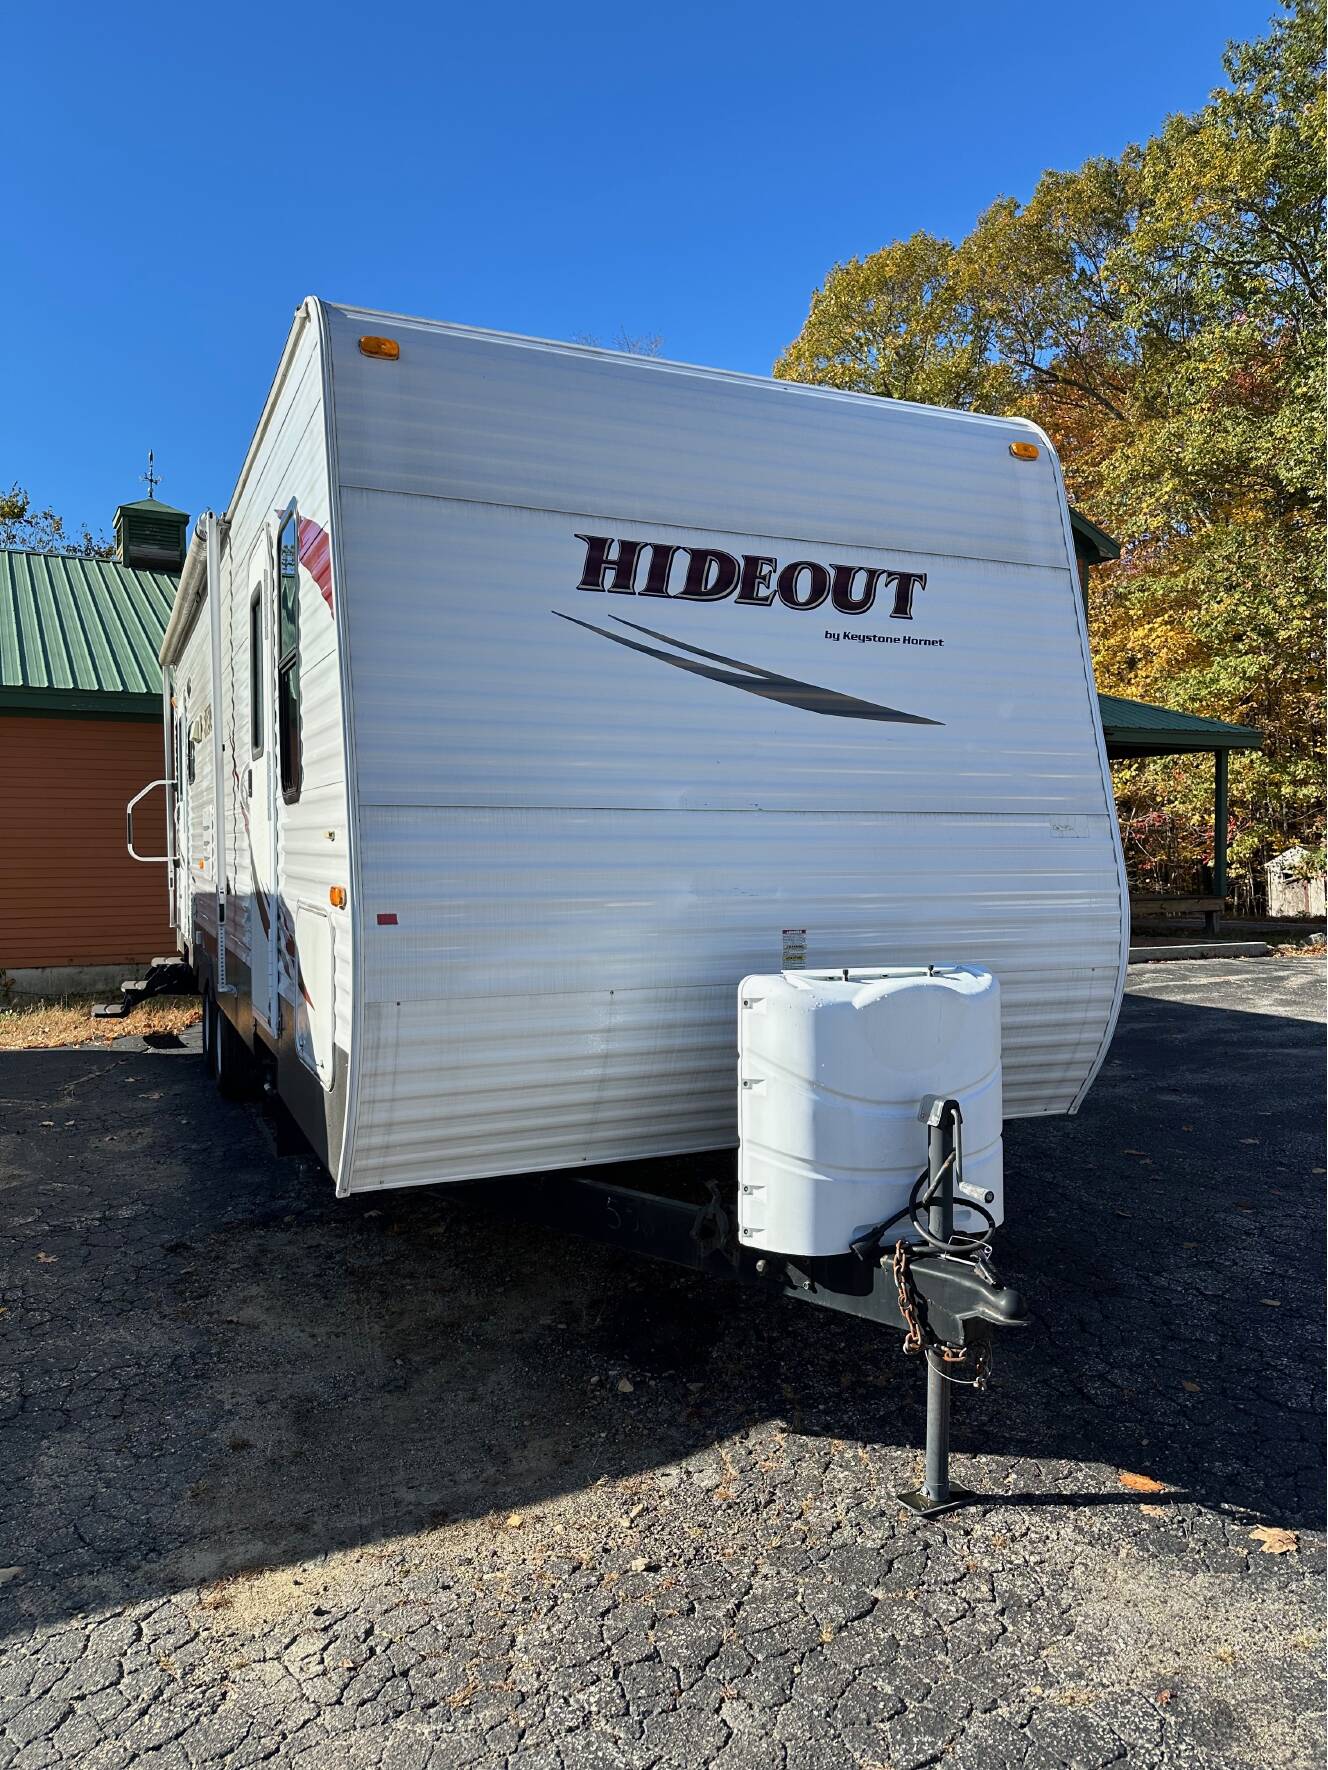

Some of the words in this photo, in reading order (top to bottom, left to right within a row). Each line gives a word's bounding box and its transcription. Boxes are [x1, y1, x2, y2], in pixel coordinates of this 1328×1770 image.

[574, 533, 928, 620] HIDEOUT
[824, 630, 840, 642] by
[842, 631, 901, 644] Keystone
[902, 635, 945, 647] Hornet
